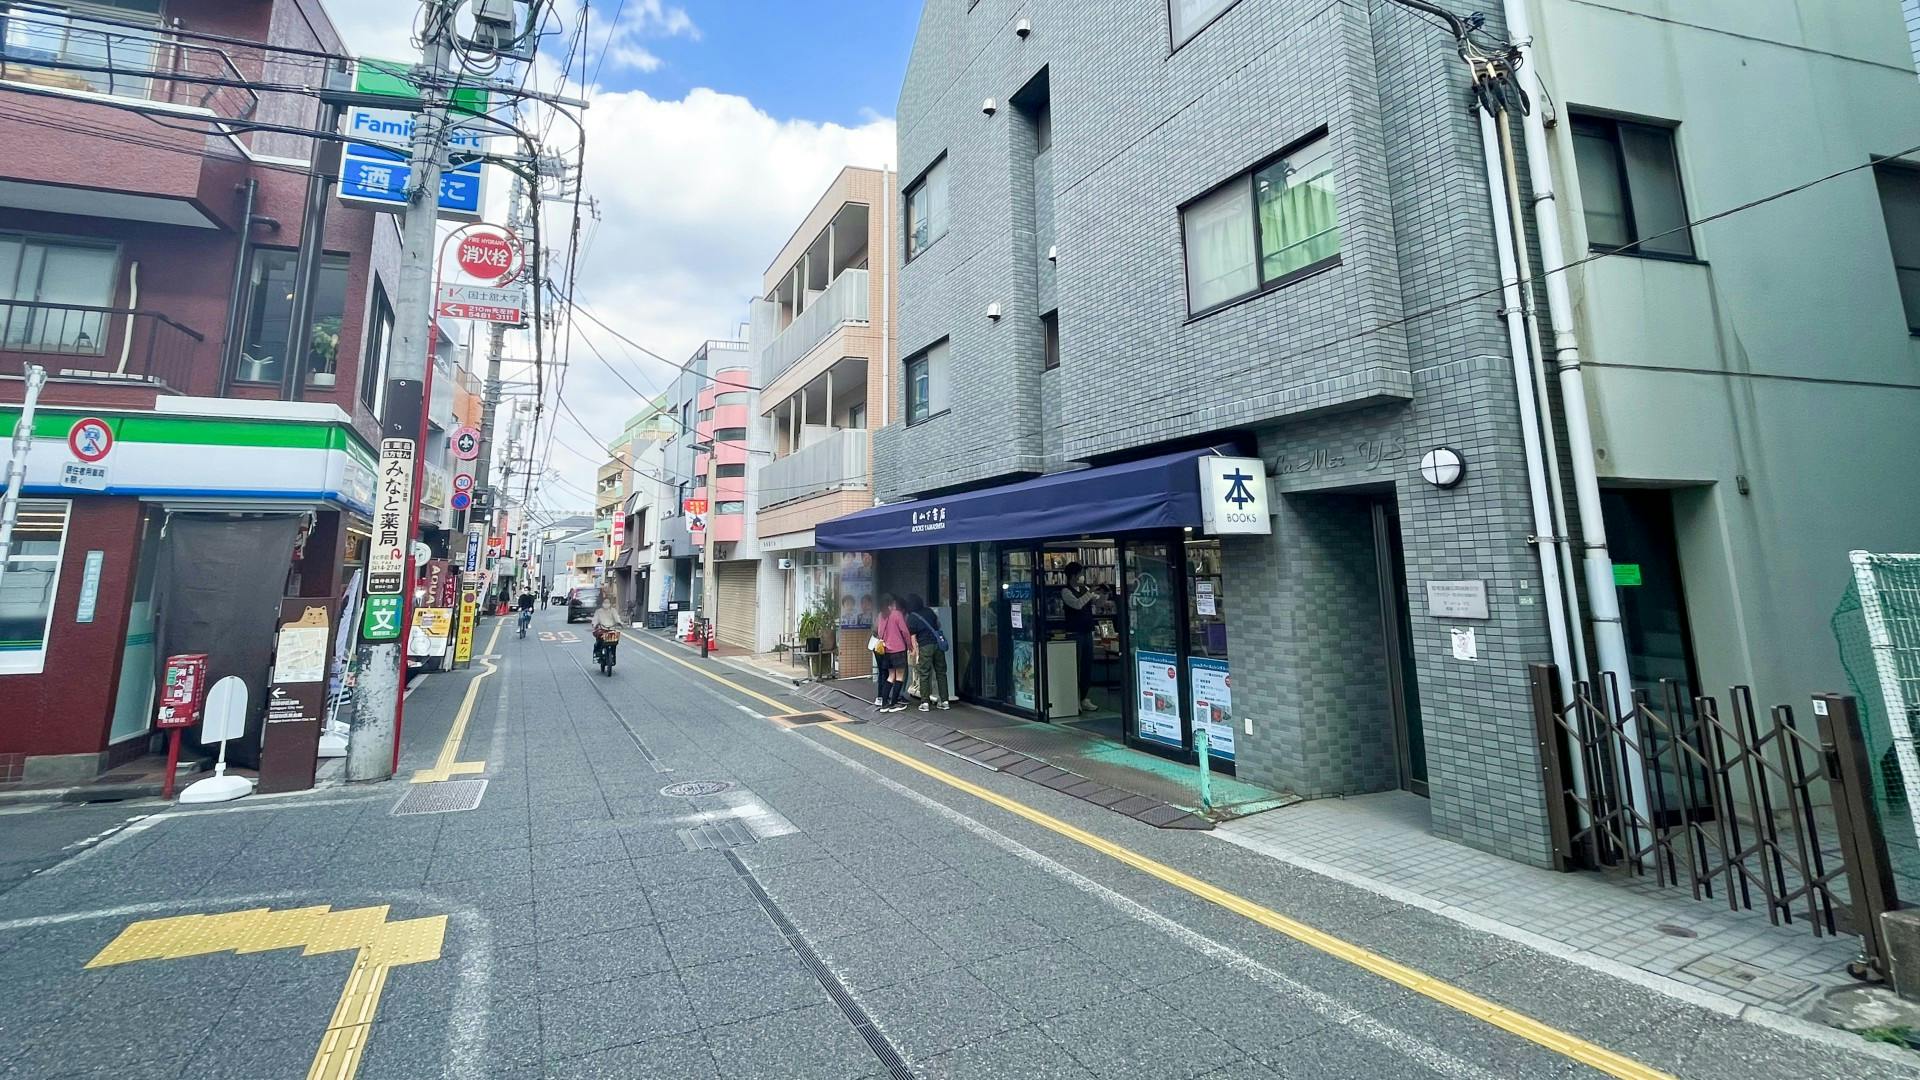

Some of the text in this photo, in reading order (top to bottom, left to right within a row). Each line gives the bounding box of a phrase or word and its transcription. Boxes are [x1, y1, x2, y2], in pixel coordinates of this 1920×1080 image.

[357, 164, 392, 194] 酒
[462, 244, 509, 267] 消火栓
[1272, 455, 1293, 475] La
[458, 478, 469, 487] 30
[1223, 468, 1256, 510] 本
[379, 460, 404, 547] みなと薬局
[1227, 513, 1257, 523] BOOKS
[370, 608, 396, 631] 文
